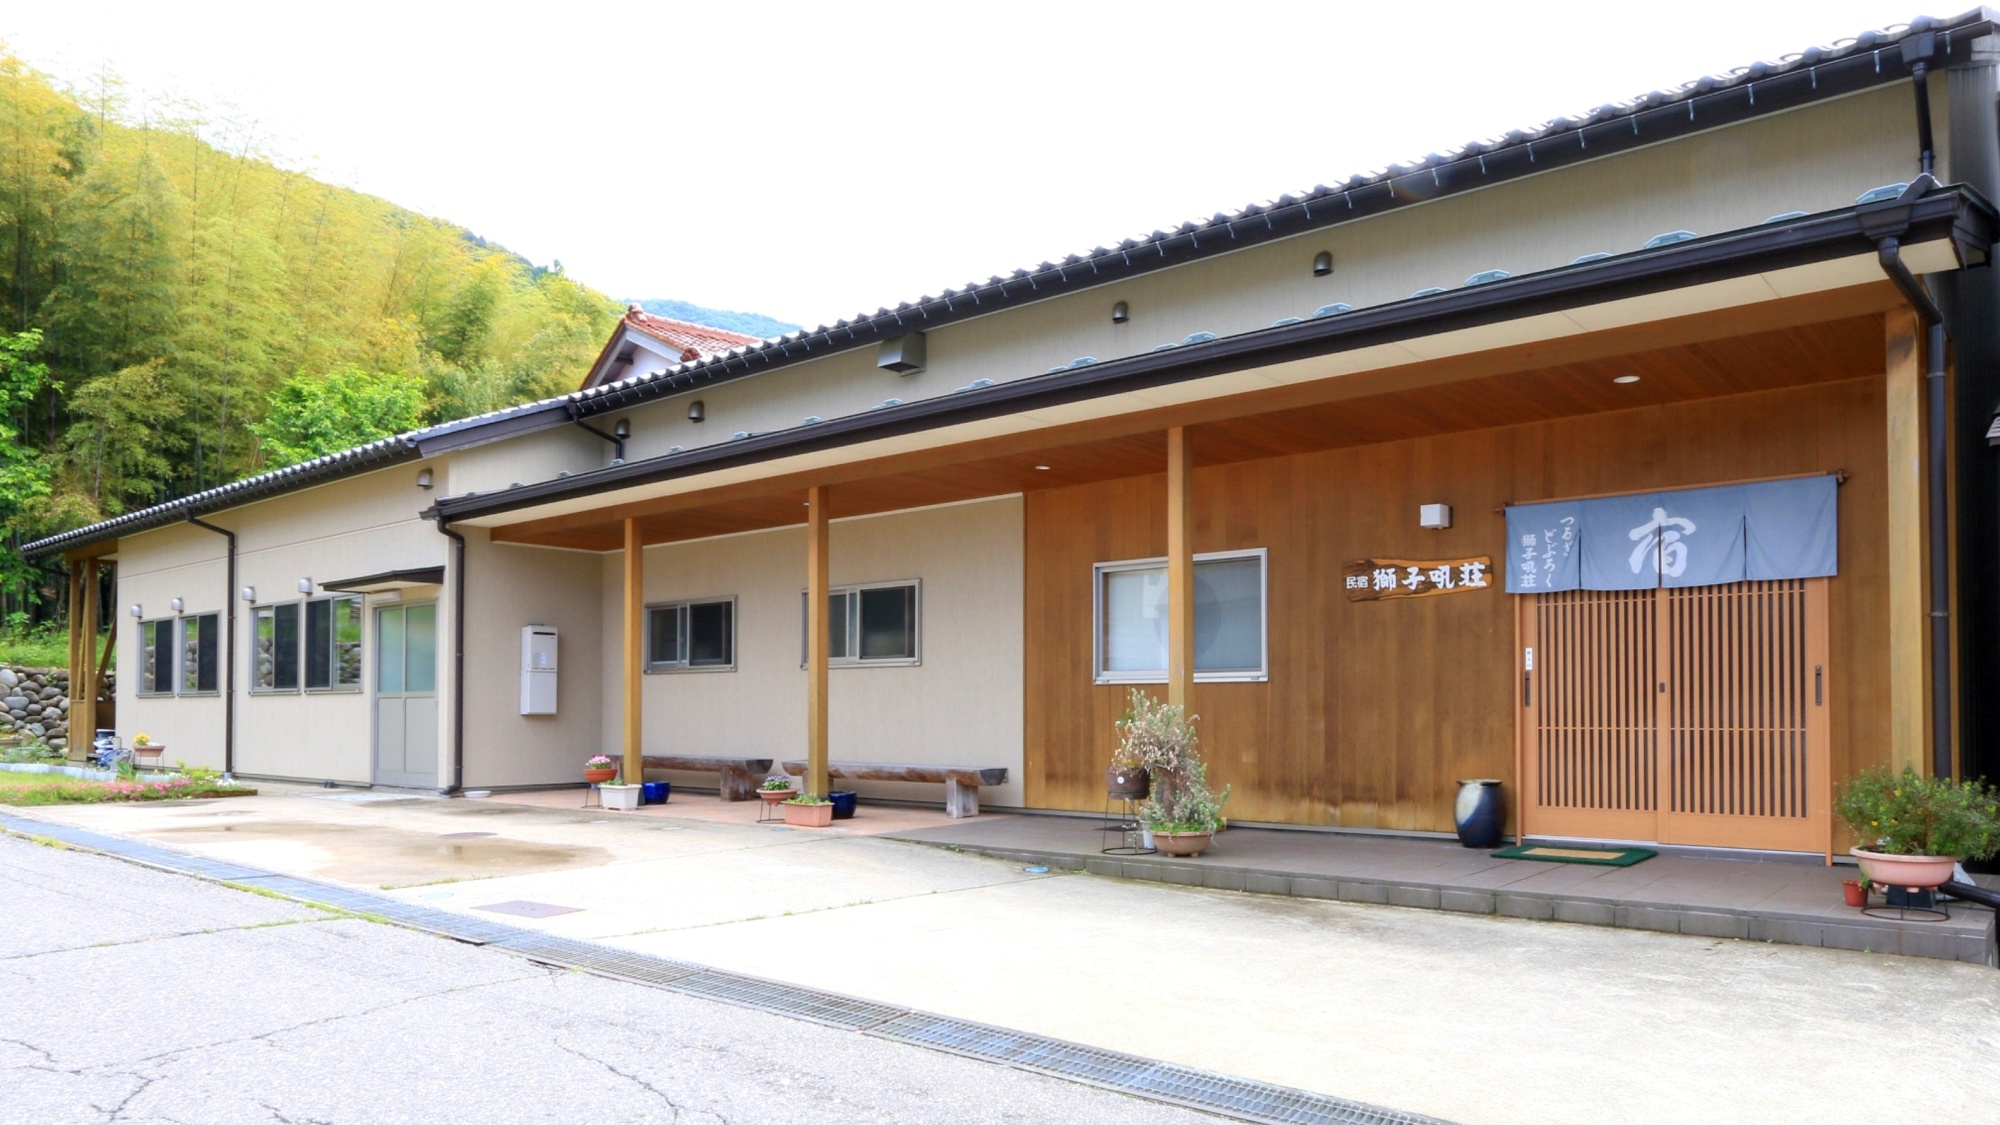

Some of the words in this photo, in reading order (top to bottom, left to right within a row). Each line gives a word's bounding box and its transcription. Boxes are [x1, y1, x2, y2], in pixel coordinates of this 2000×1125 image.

[1520, 534, 1537, 588] 獅子吼荘
[1542, 528, 1557, 588] どぶろく
[1560, 516, 1575, 557] つるぎ
[1628, 507, 1696, 577] 宿
[1346, 576, 1369, 589] 民宿
[1372, 561, 1487, 591] 獅子吼荘
